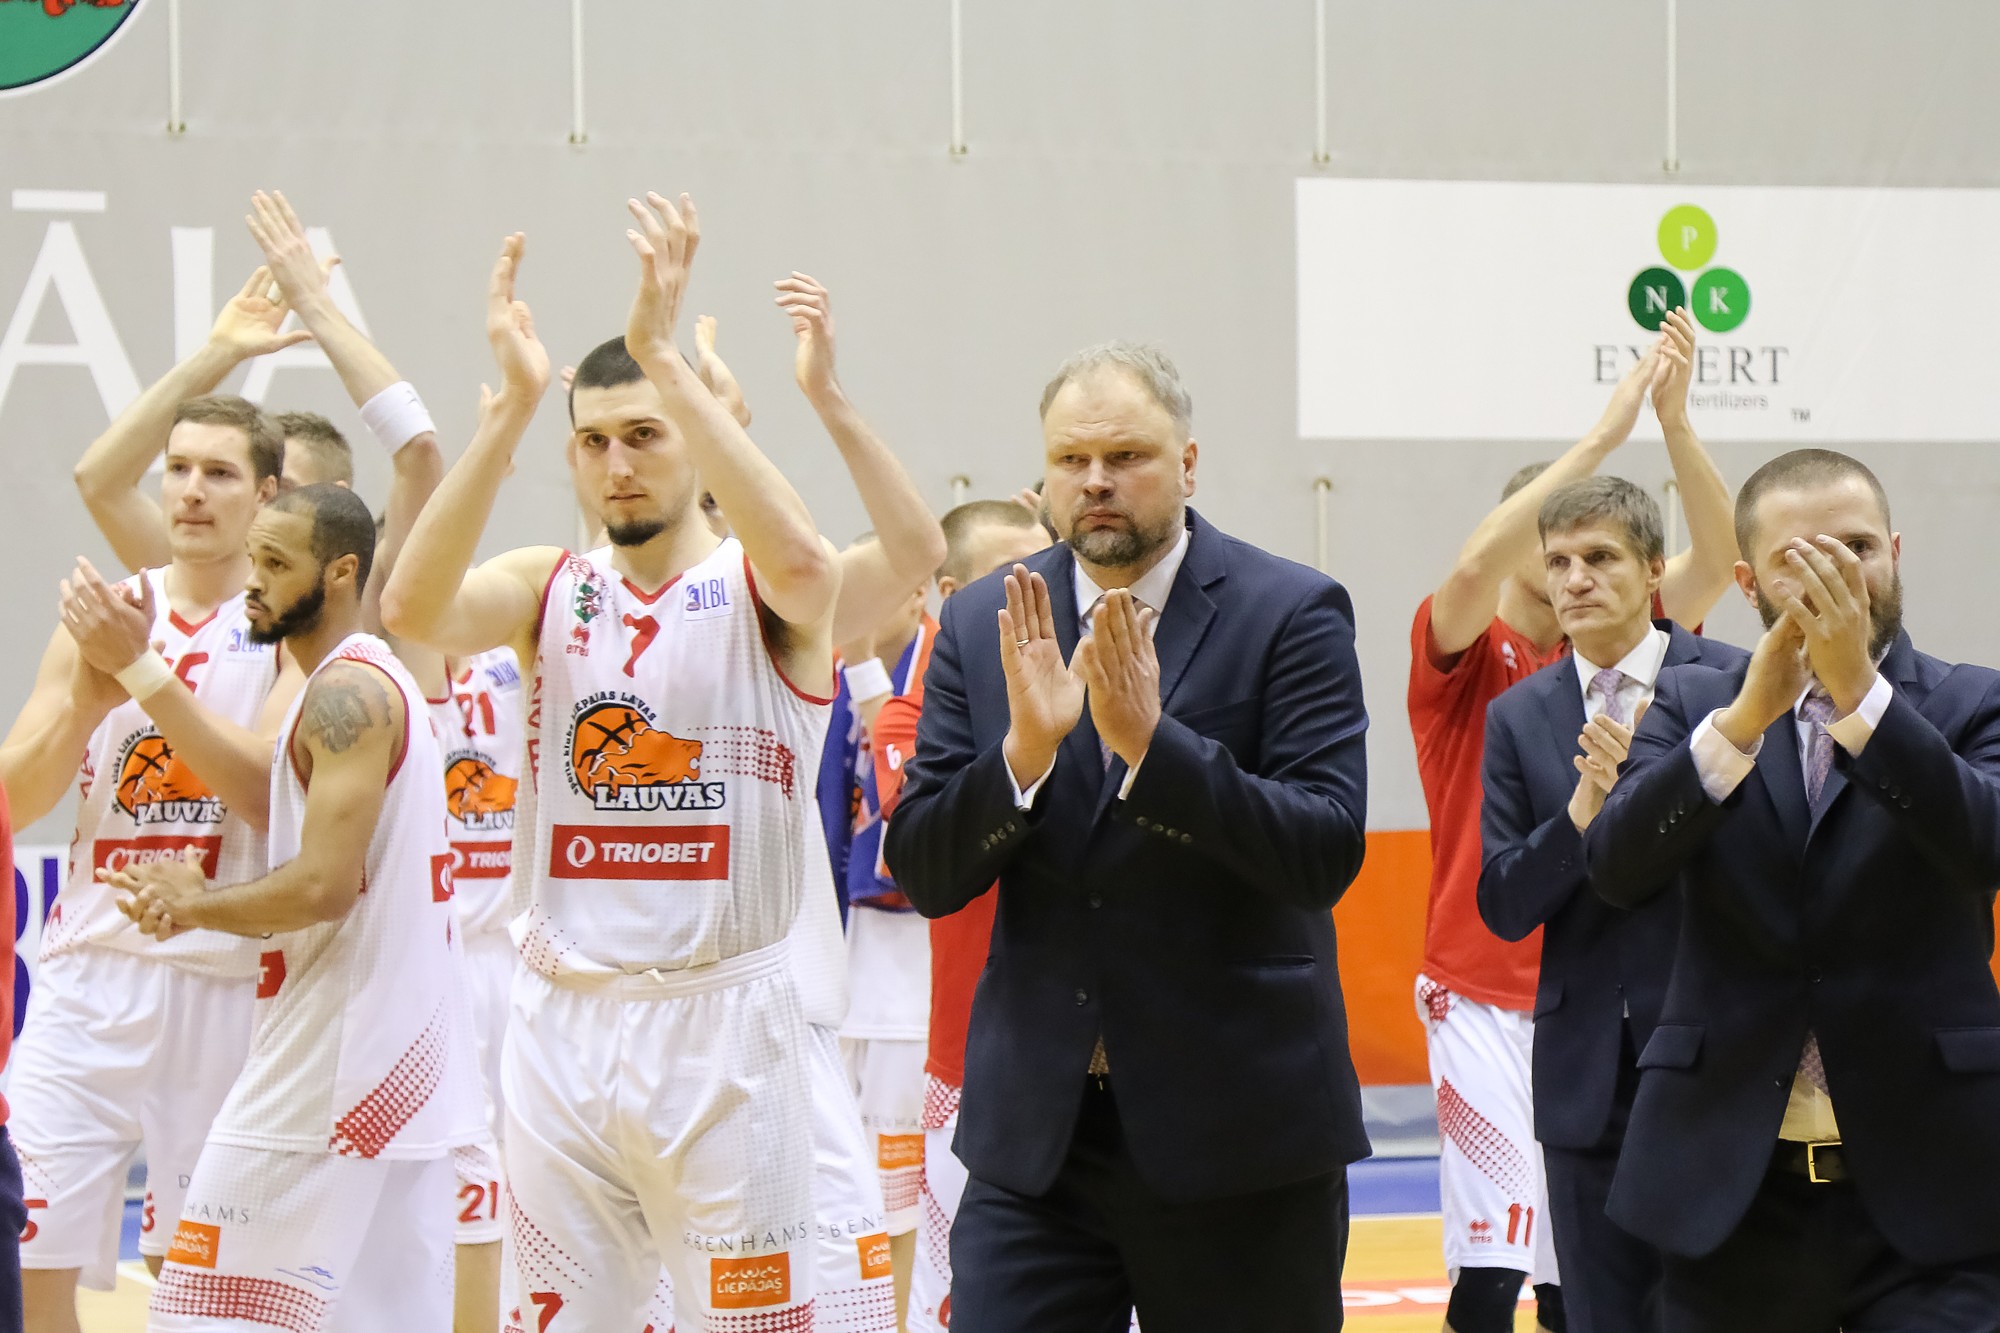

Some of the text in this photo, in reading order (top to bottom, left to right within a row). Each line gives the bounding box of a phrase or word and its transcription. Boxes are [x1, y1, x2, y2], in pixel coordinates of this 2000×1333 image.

[1681, 225, 1698, 251] P
[1644, 285, 1668, 314] N
[1709, 286, 1731, 315] K
[1594, 344, 1789, 383] EERT
[701, 577, 730, 610] LBL
[622, 613, 661, 679] 7
[594, 782, 726, 811] LAUVAS
[135, 799, 227, 826] LAUVAS
[463, 810, 514, 831] LAUV
[468, 851, 512, 868] TRIO
[600, 842, 715, 863] TRIOBET
[456, 1180, 499, 1224] 21
[1506, 1203, 1535, 1248] 11
[530, 1291, 564, 1333] 7
